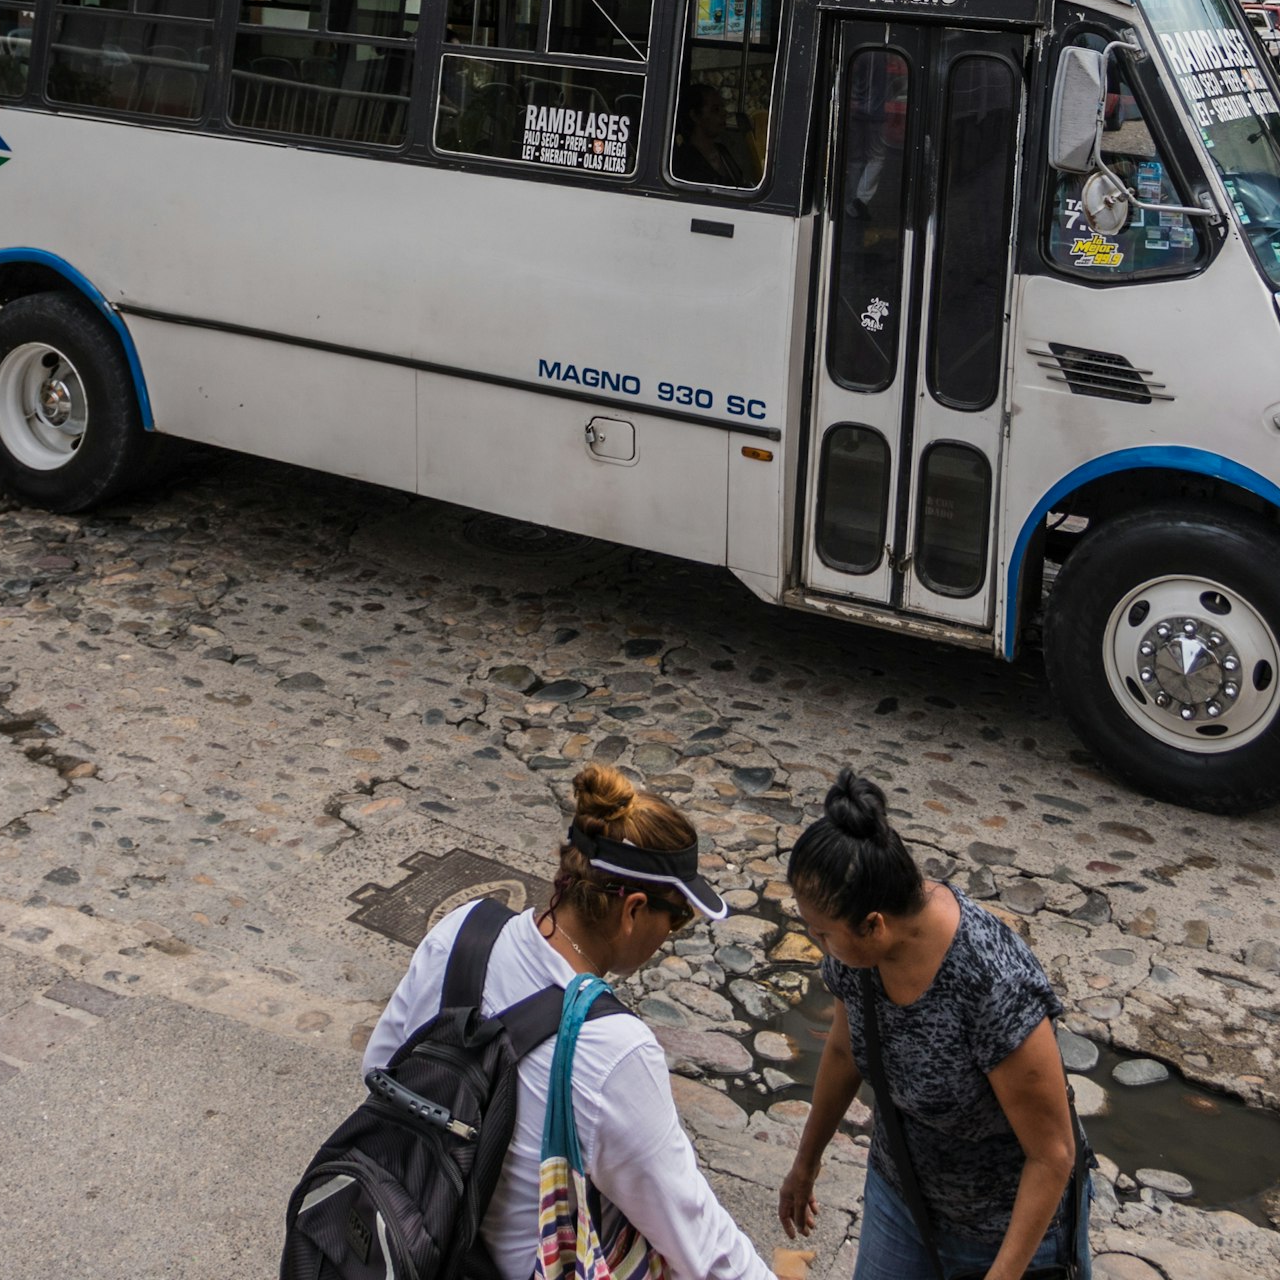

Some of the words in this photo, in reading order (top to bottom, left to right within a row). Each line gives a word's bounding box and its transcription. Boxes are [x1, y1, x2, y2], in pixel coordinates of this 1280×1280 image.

[524, 104, 631, 143] RAMBLASES
[522, 130, 540, 146] PALO
[540, 132, 560, 149] SECO
[564, 135, 587, 153] PREPA
[603, 140, 627, 158] MEGA
[521, 144, 536, 161] LEY
[539, 147, 578, 167] SHERATON
[583, 153, 603, 171] OLAS
[602, 155, 627, 174] ALTAS
[1064, 209, 1096, 233] 7.
[1092, 252, 1122, 266] 99.9
[537, 358, 641, 395] MAGNO
[657, 381, 713, 410] 930
[726, 394, 767, 420] SC
